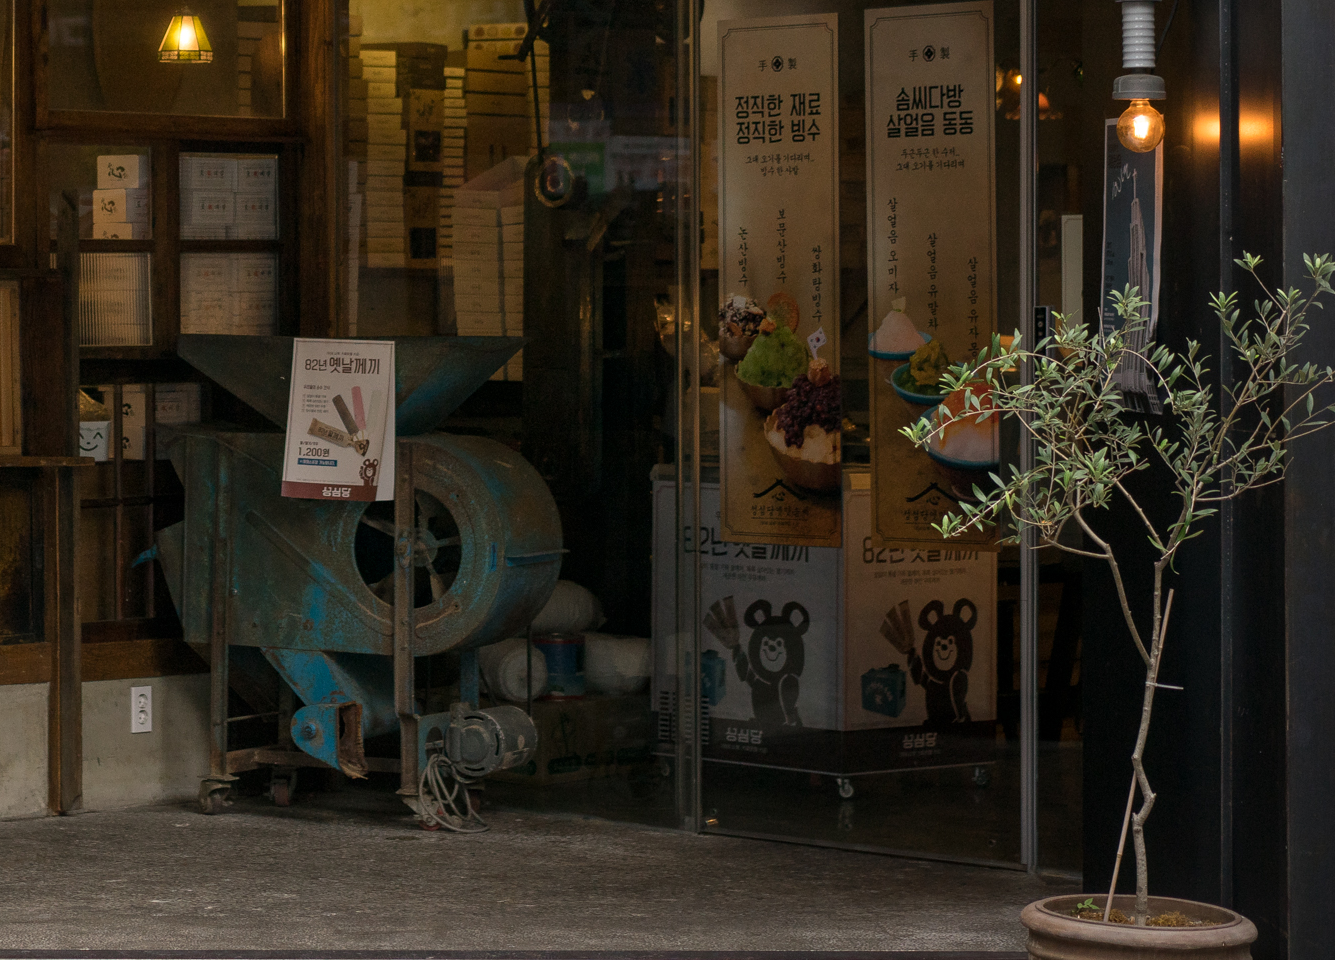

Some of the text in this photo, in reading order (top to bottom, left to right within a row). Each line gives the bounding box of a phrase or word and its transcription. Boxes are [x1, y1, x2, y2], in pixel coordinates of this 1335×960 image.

[735, 93, 821, 119] 정직한 재료
[896, 84, 964, 112] 솜씨다방
[736, 119, 820, 144] 정직한 빙수
[886, 110, 974, 138] 살얼음 동동
[304, 357, 380, 375] 82년 옛날께끼
[298, 447, 330, 457] 1,200원
[322, 486, 352, 498] 성심당
[725, 727, 763, 745] 성심당
[902, 732, 938, 749] 성심당
